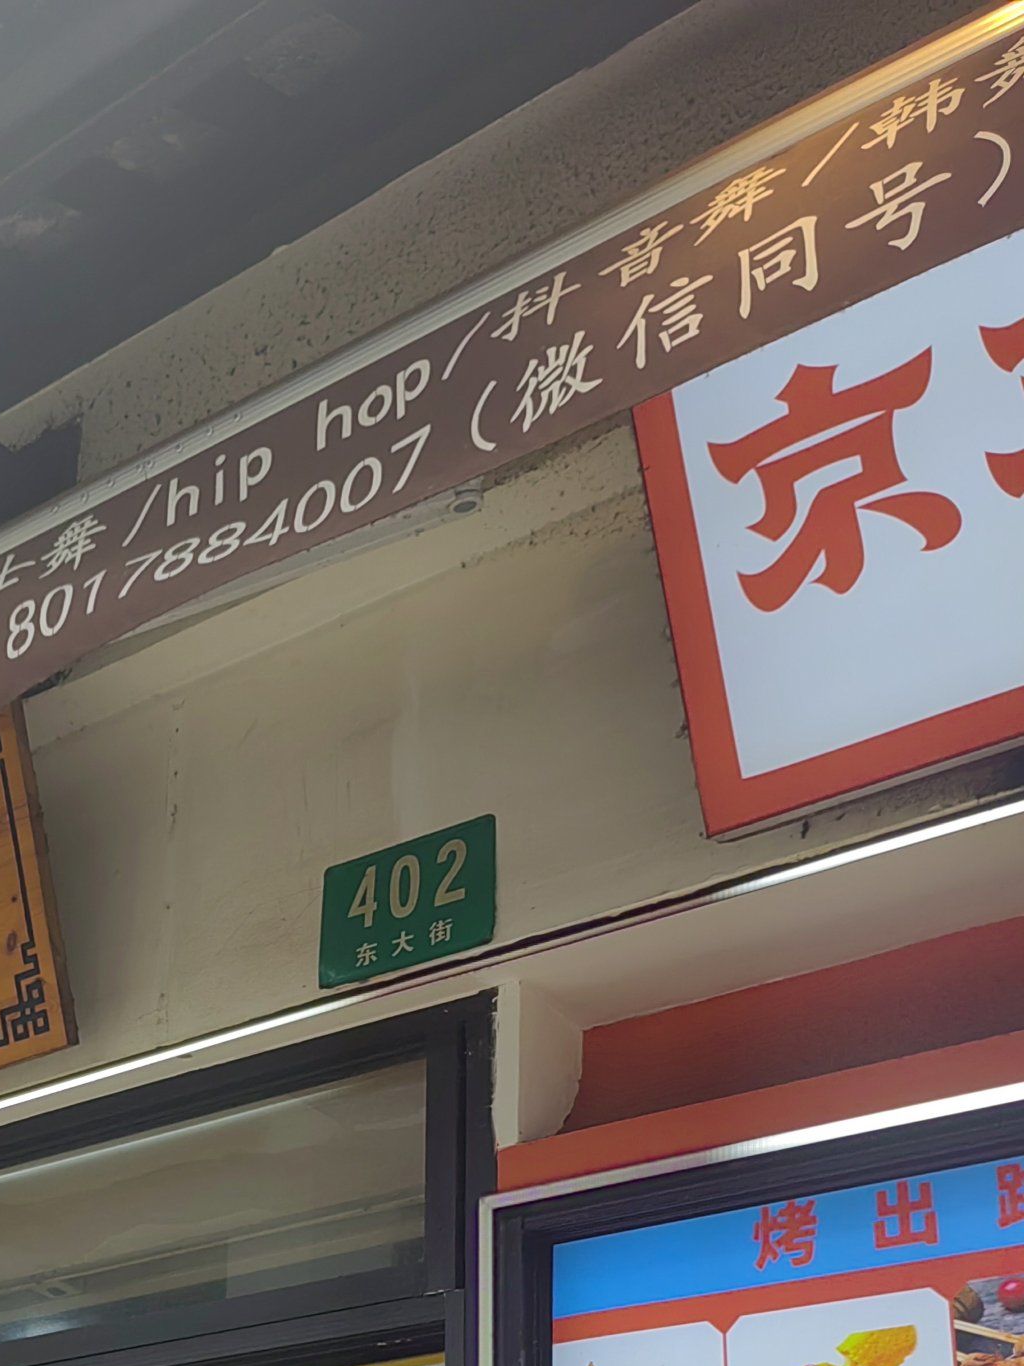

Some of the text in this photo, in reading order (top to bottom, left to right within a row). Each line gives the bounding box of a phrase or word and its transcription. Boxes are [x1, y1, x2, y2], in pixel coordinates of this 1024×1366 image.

[707, 321, 1024, 613] 京
[347, 838, 467, 928] 402
[355, 918, 453, 968] 东大街
